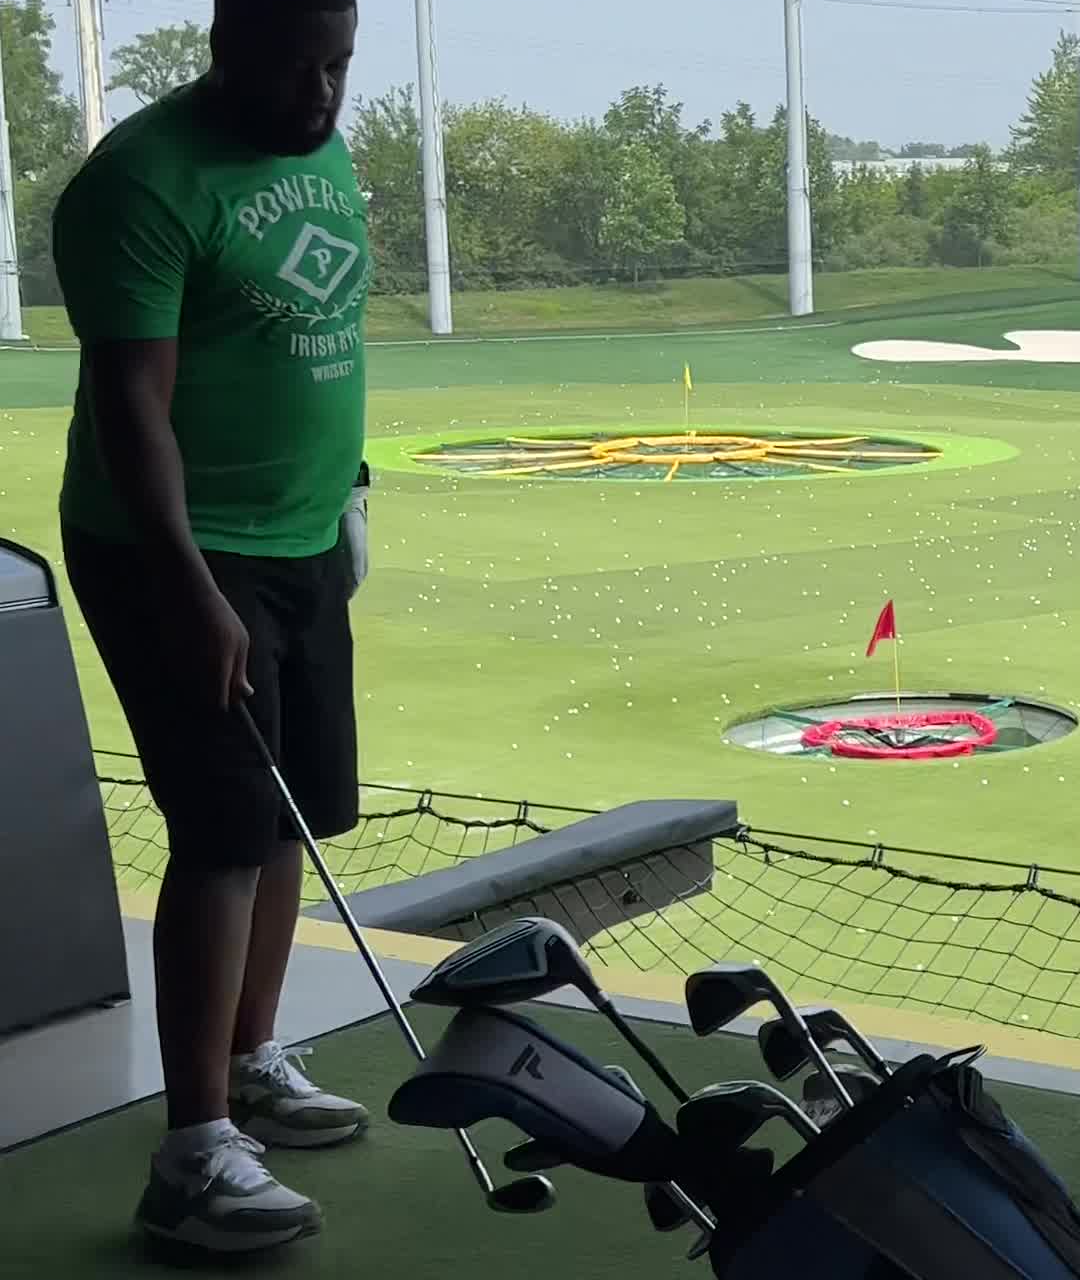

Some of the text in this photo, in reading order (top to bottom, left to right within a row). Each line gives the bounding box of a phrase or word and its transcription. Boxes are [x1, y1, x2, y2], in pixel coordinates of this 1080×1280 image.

[238, 174, 354, 240] POWERS
[290, 323, 360, 357] IRISH RYE
